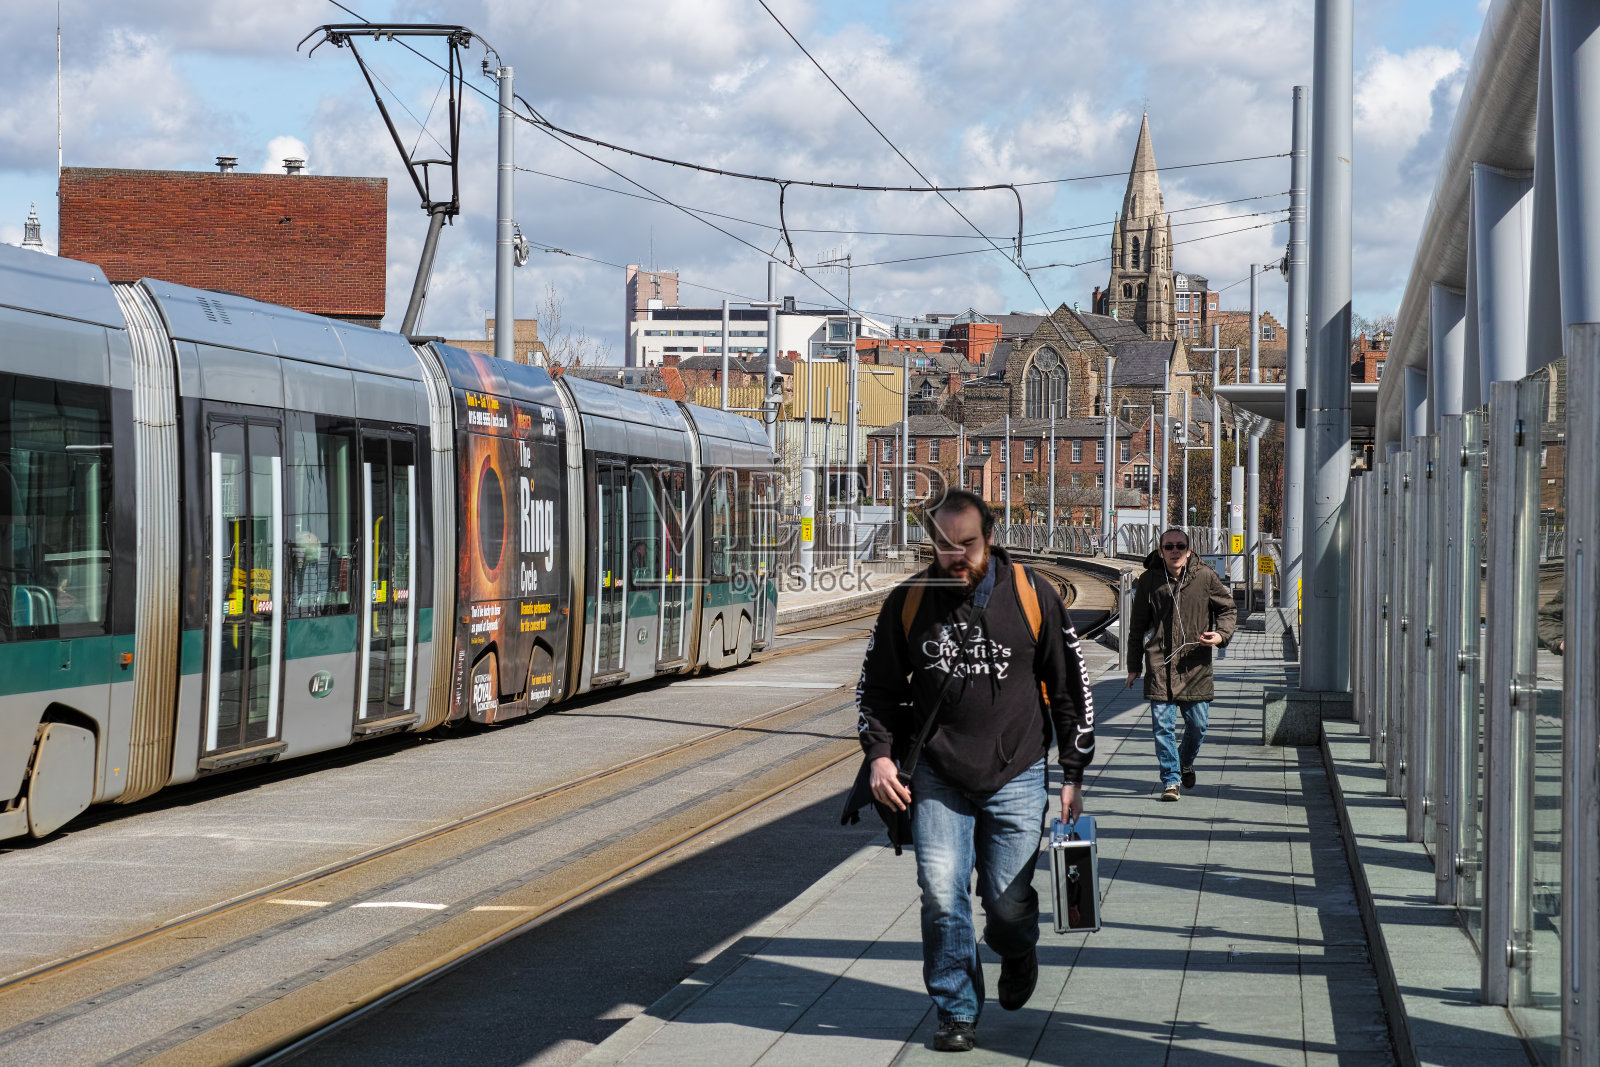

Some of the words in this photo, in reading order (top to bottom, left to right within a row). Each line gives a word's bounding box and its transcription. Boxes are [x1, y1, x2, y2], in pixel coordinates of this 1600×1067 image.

[519, 440, 531, 468] The
[520, 476, 554, 572] Ring
[520, 561, 538, 597] Cycle
[922, 640, 1012, 658] Charlie's
[473, 681, 492, 706] ROYAL
